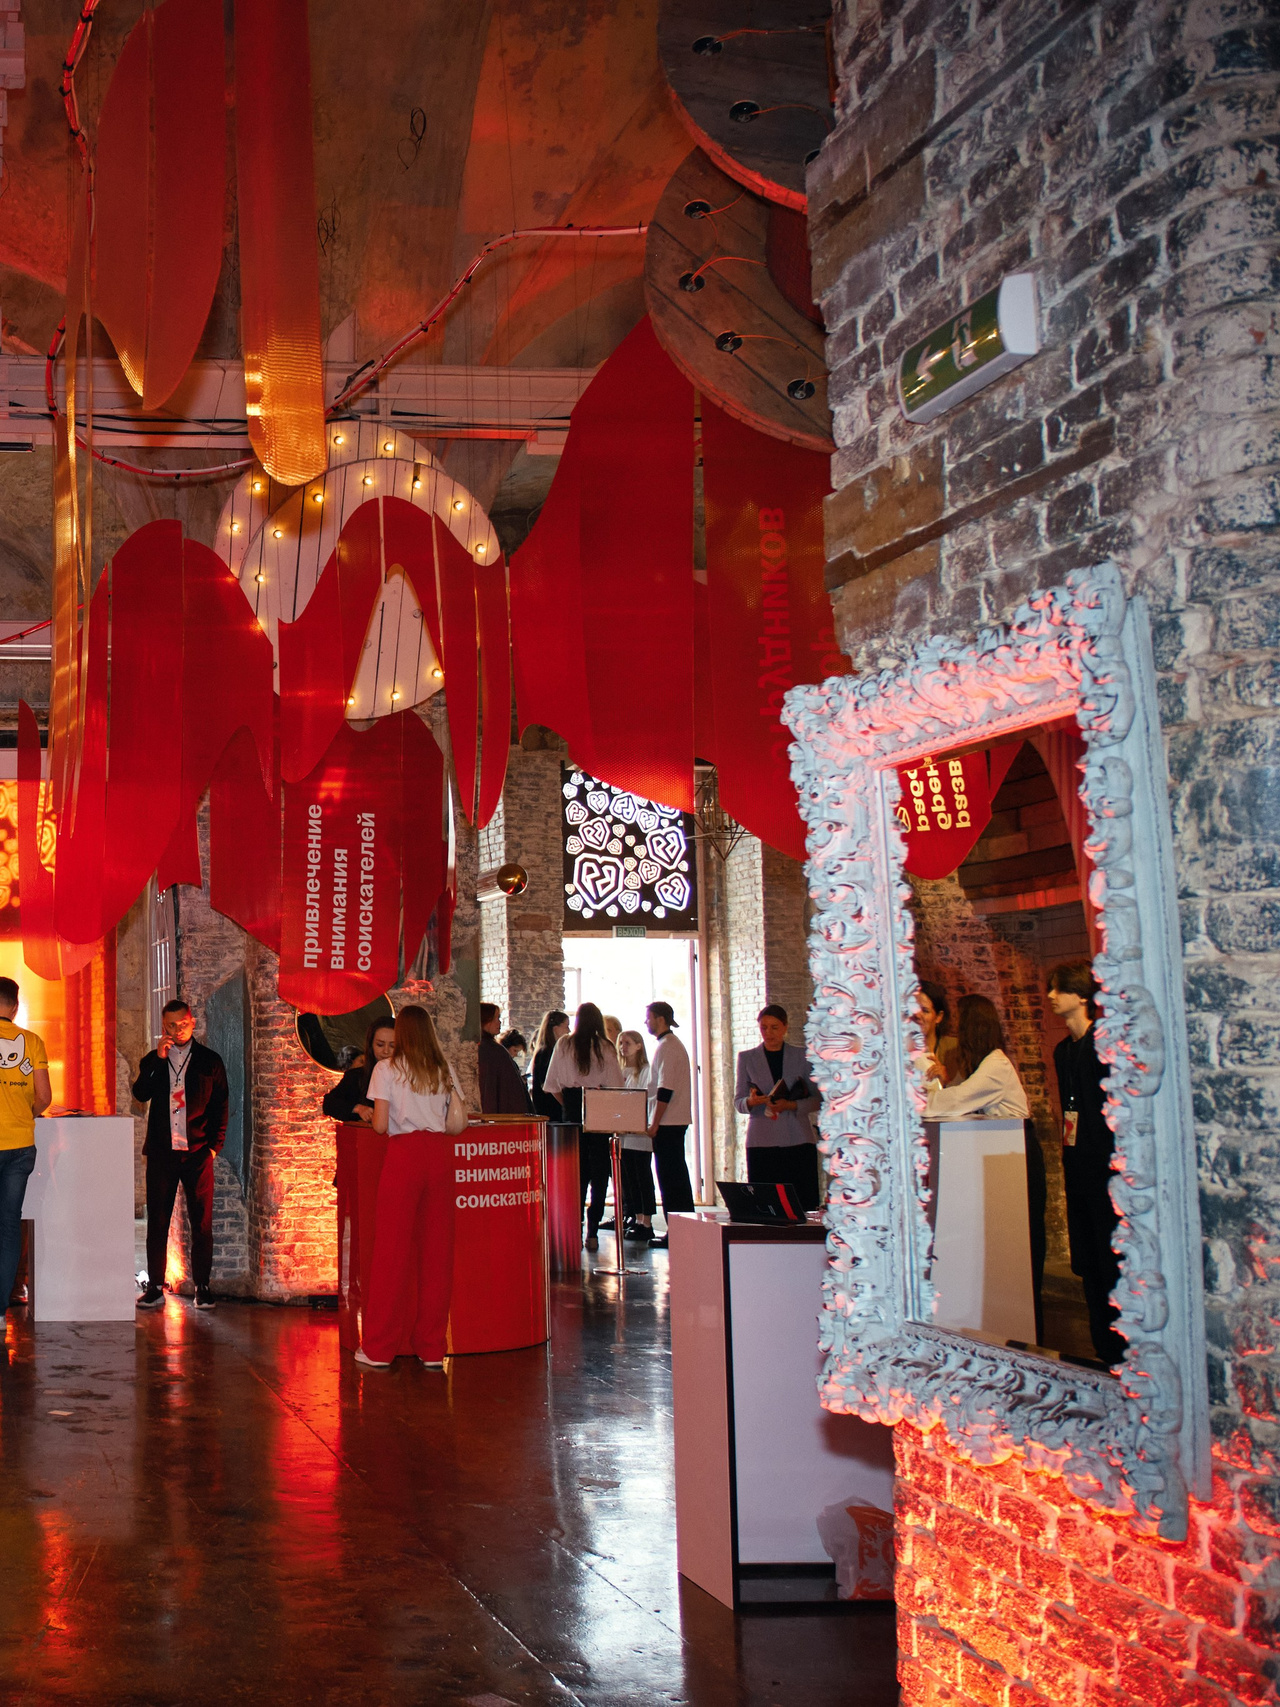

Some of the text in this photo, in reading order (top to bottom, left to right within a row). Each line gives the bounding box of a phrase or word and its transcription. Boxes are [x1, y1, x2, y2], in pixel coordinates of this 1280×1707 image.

[304, 804, 323, 968] привлечение
[331, 848, 348, 970] внимания
[357, 812, 376, 972] соискателей
[617, 928, 644, 937] ВЫХОД
[455, 1166, 531, 1183] внимания
